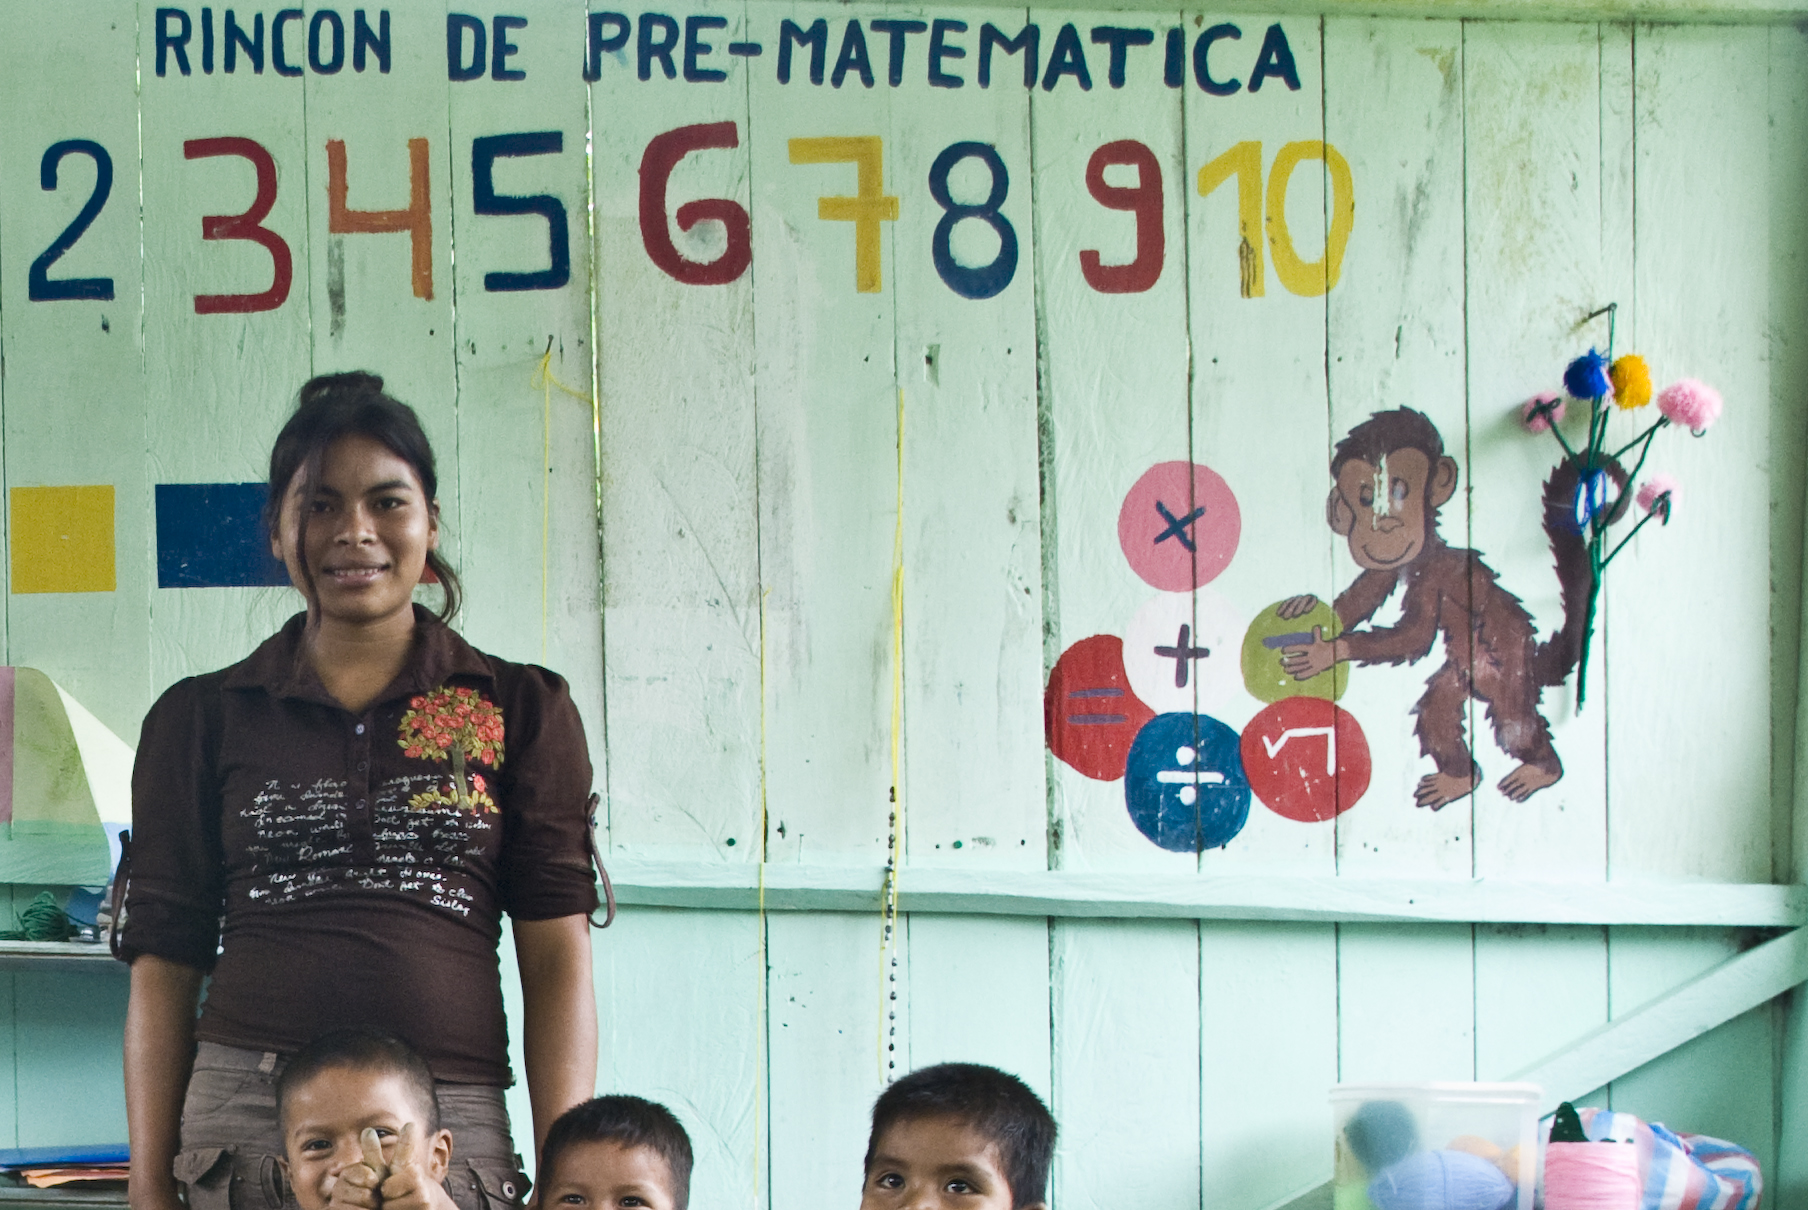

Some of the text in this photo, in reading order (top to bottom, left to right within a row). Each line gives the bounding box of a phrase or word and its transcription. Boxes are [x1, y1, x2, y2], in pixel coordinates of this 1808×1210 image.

[154, 7, 1301, 96] RINCON DE PRE-MATEMATICA
[28, 139, 115, 302] 2
[182, 136, 293, 315] 3
[325, 137, 435, 301] 4
[472, 131, 571, 293] 5
[637, 120, 752, 286] 6
[787, 135, 900, 294] 7
[927, 140, 1019, 300] 8
[1078, 138, 1165, 295] 9
[1196, 139, 1355, 299] 10
